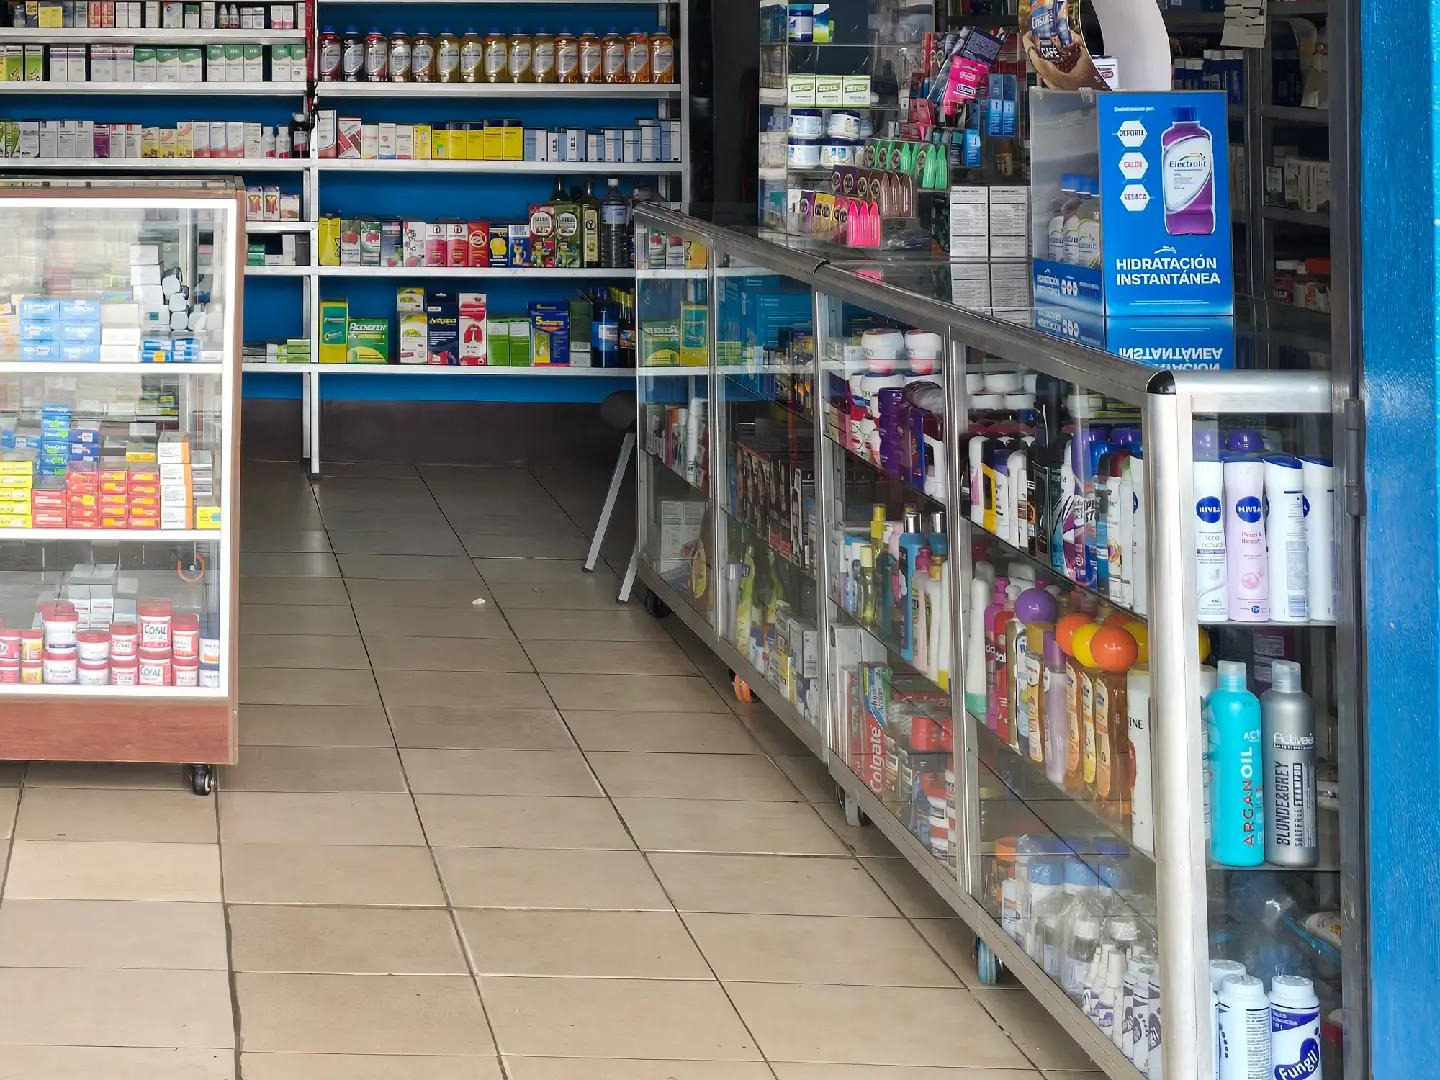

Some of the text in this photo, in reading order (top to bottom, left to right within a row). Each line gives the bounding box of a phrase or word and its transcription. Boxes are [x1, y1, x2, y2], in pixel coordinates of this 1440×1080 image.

[1116, 254, 1217, 272] HIDRATACIÓN
[1116, 270, 1221, 286] INSTANTÁNEA
[869, 725, 884, 793] Colgate
